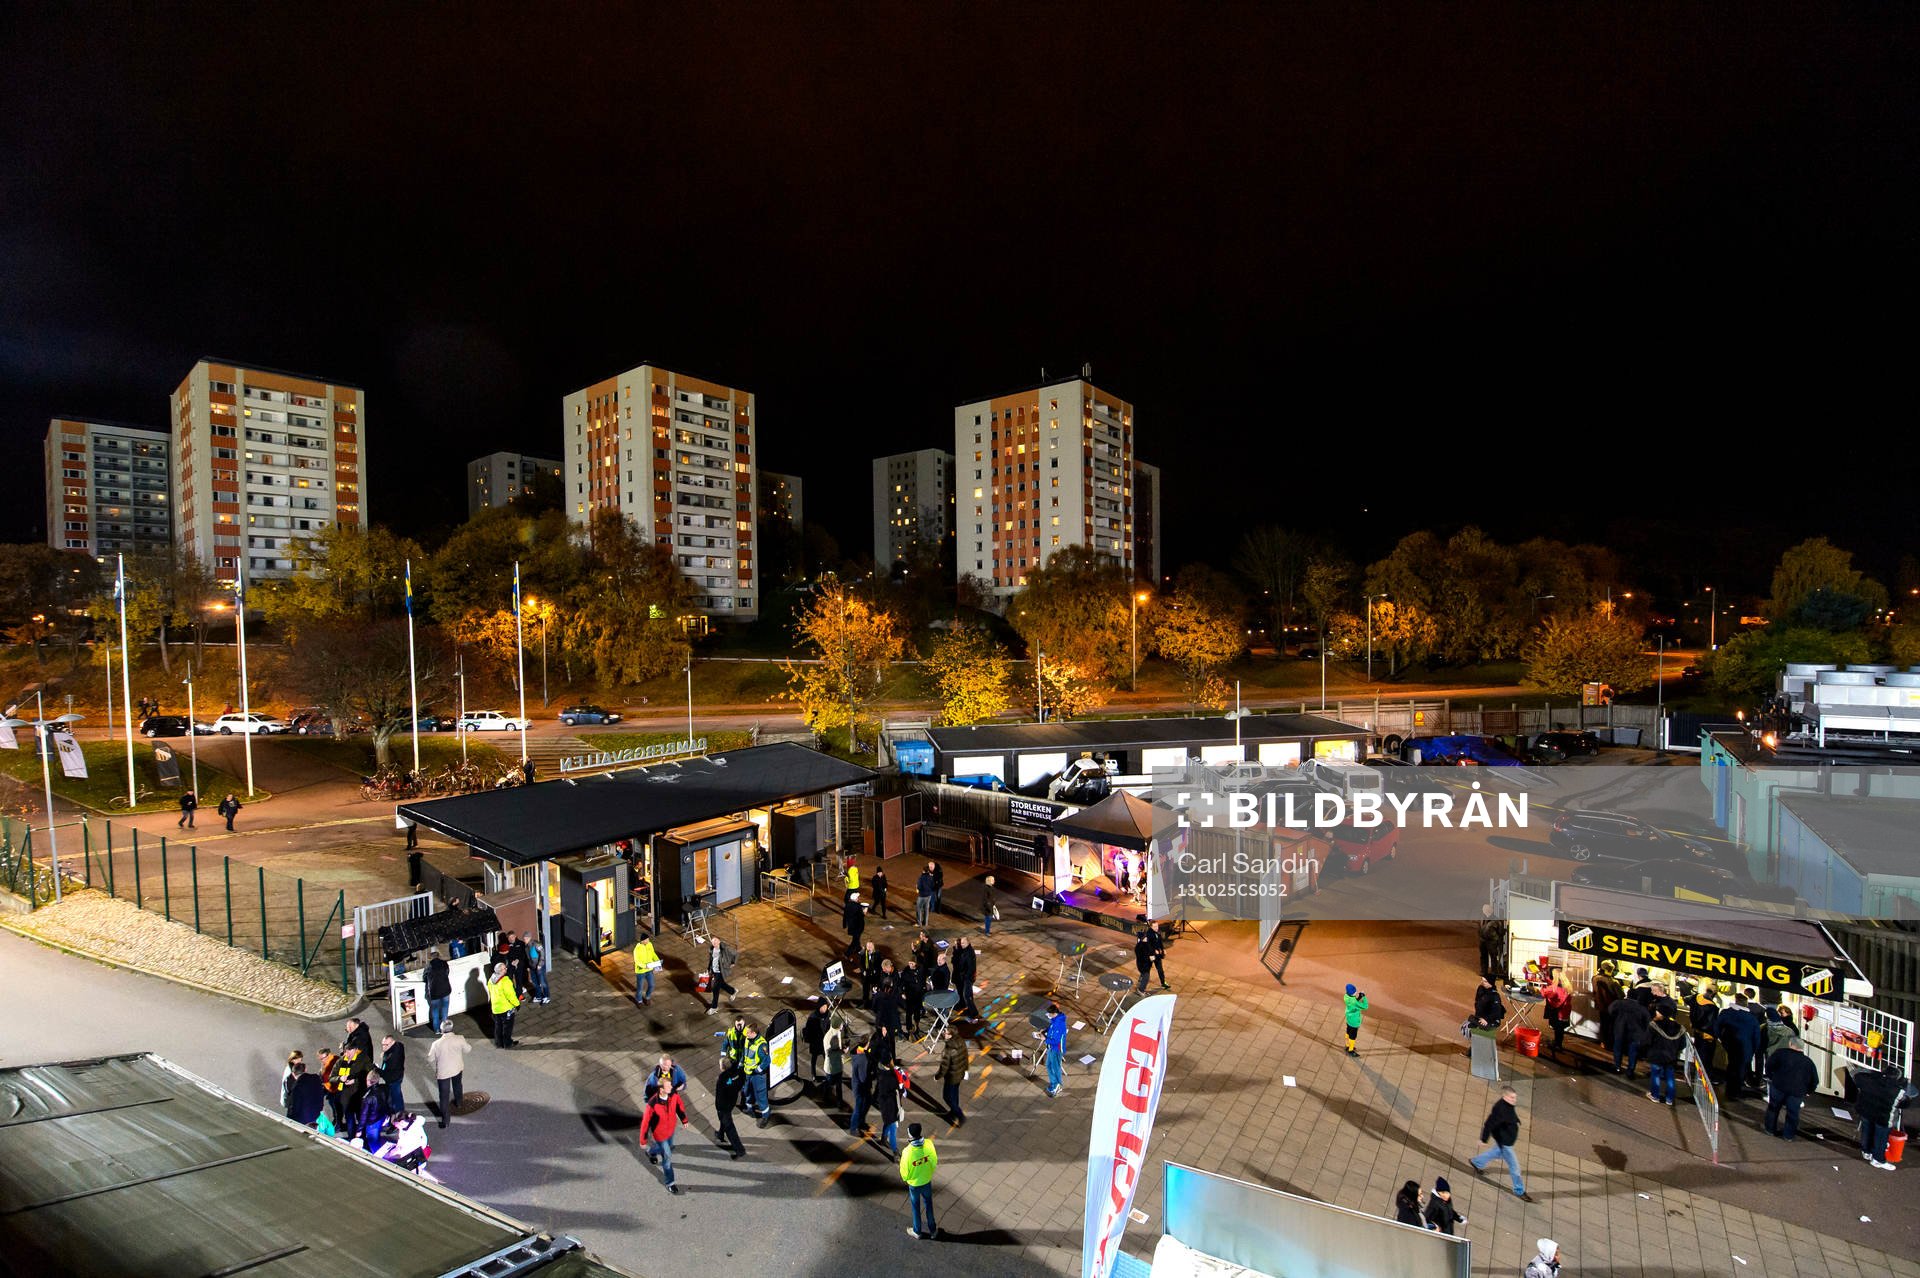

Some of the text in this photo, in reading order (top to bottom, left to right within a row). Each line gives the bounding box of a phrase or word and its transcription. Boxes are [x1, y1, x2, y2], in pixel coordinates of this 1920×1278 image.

[1601, 934, 1791, 985] SERVERING
[1121, 1017, 1161, 1114] GT
[911, 1155, 929, 1167] GT
